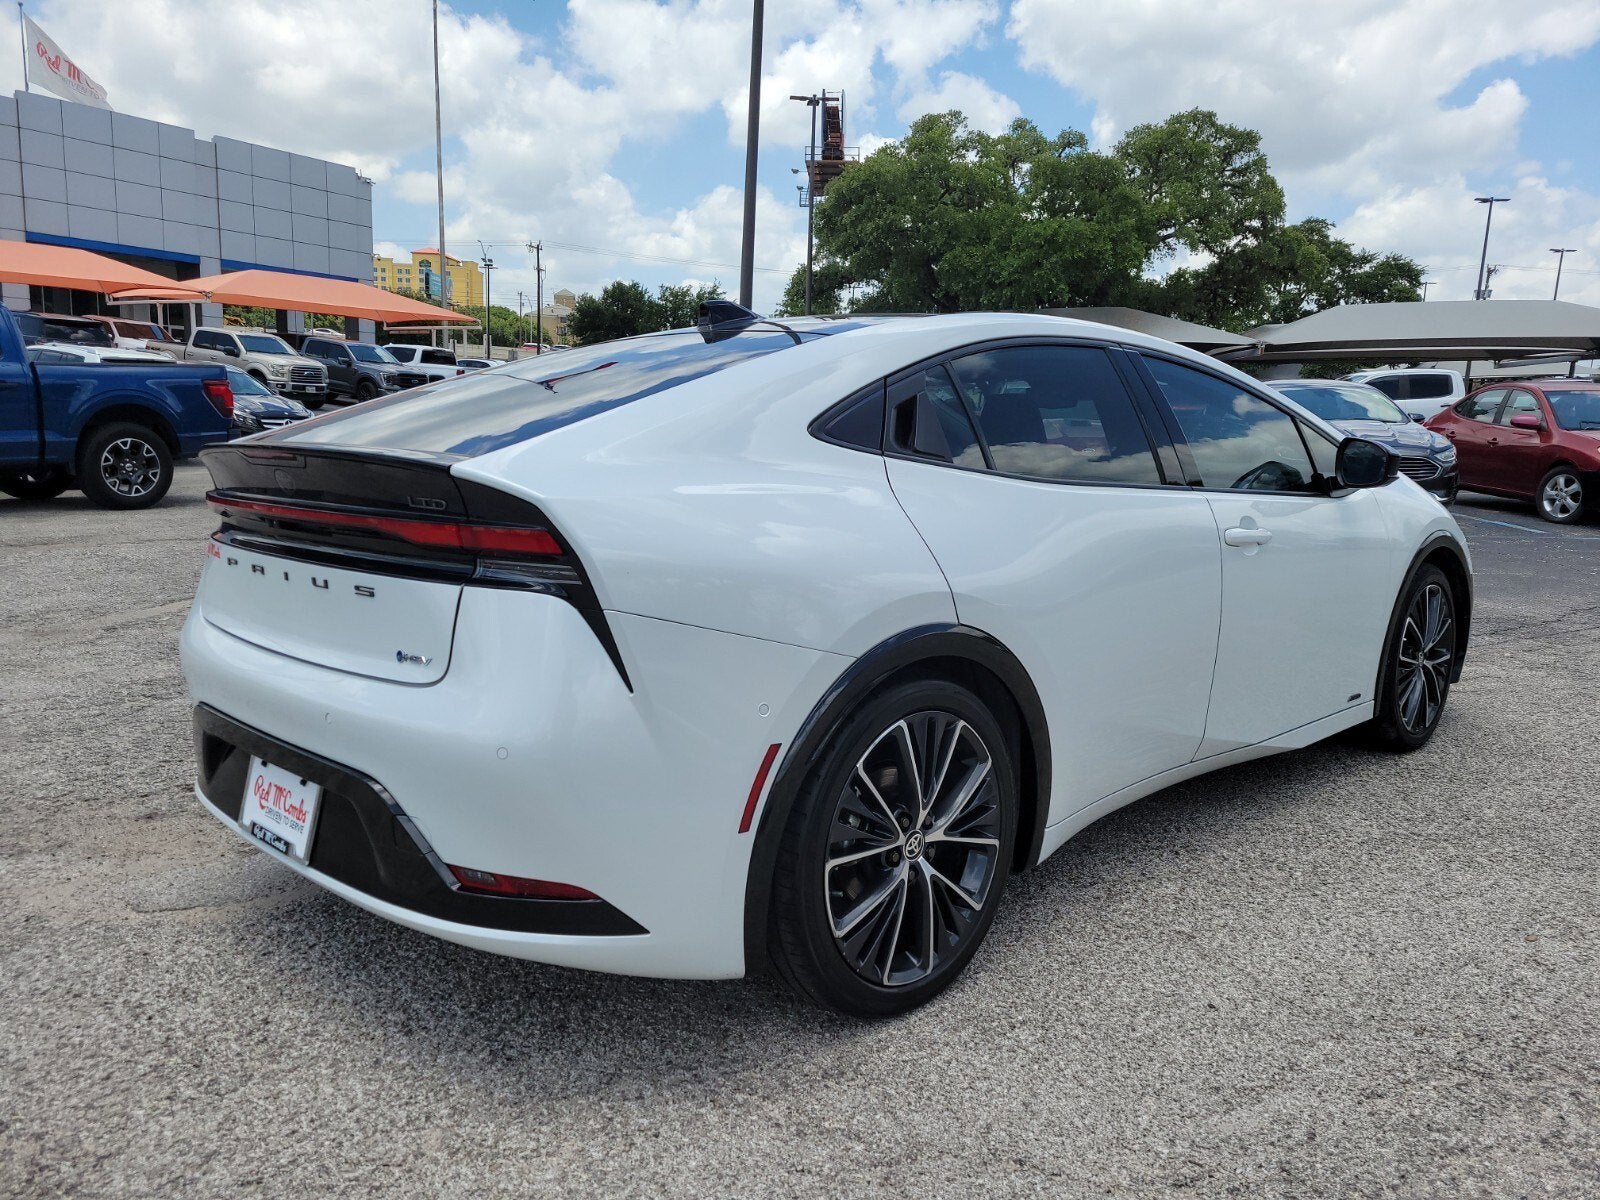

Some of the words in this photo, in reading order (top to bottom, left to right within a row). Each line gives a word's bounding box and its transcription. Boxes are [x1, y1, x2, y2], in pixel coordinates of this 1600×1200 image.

[37, 42, 60, 74] Red
[407, 496, 447, 510] LTD
[227, 557, 375, 598] PRIUS
[254, 775, 272, 810] Red
[273, 784, 307, 824] McCombs
[265, 806, 282, 822] DRIVEN
[282, 815, 290, 825] TO
[289, 819, 305, 834] SERVE
